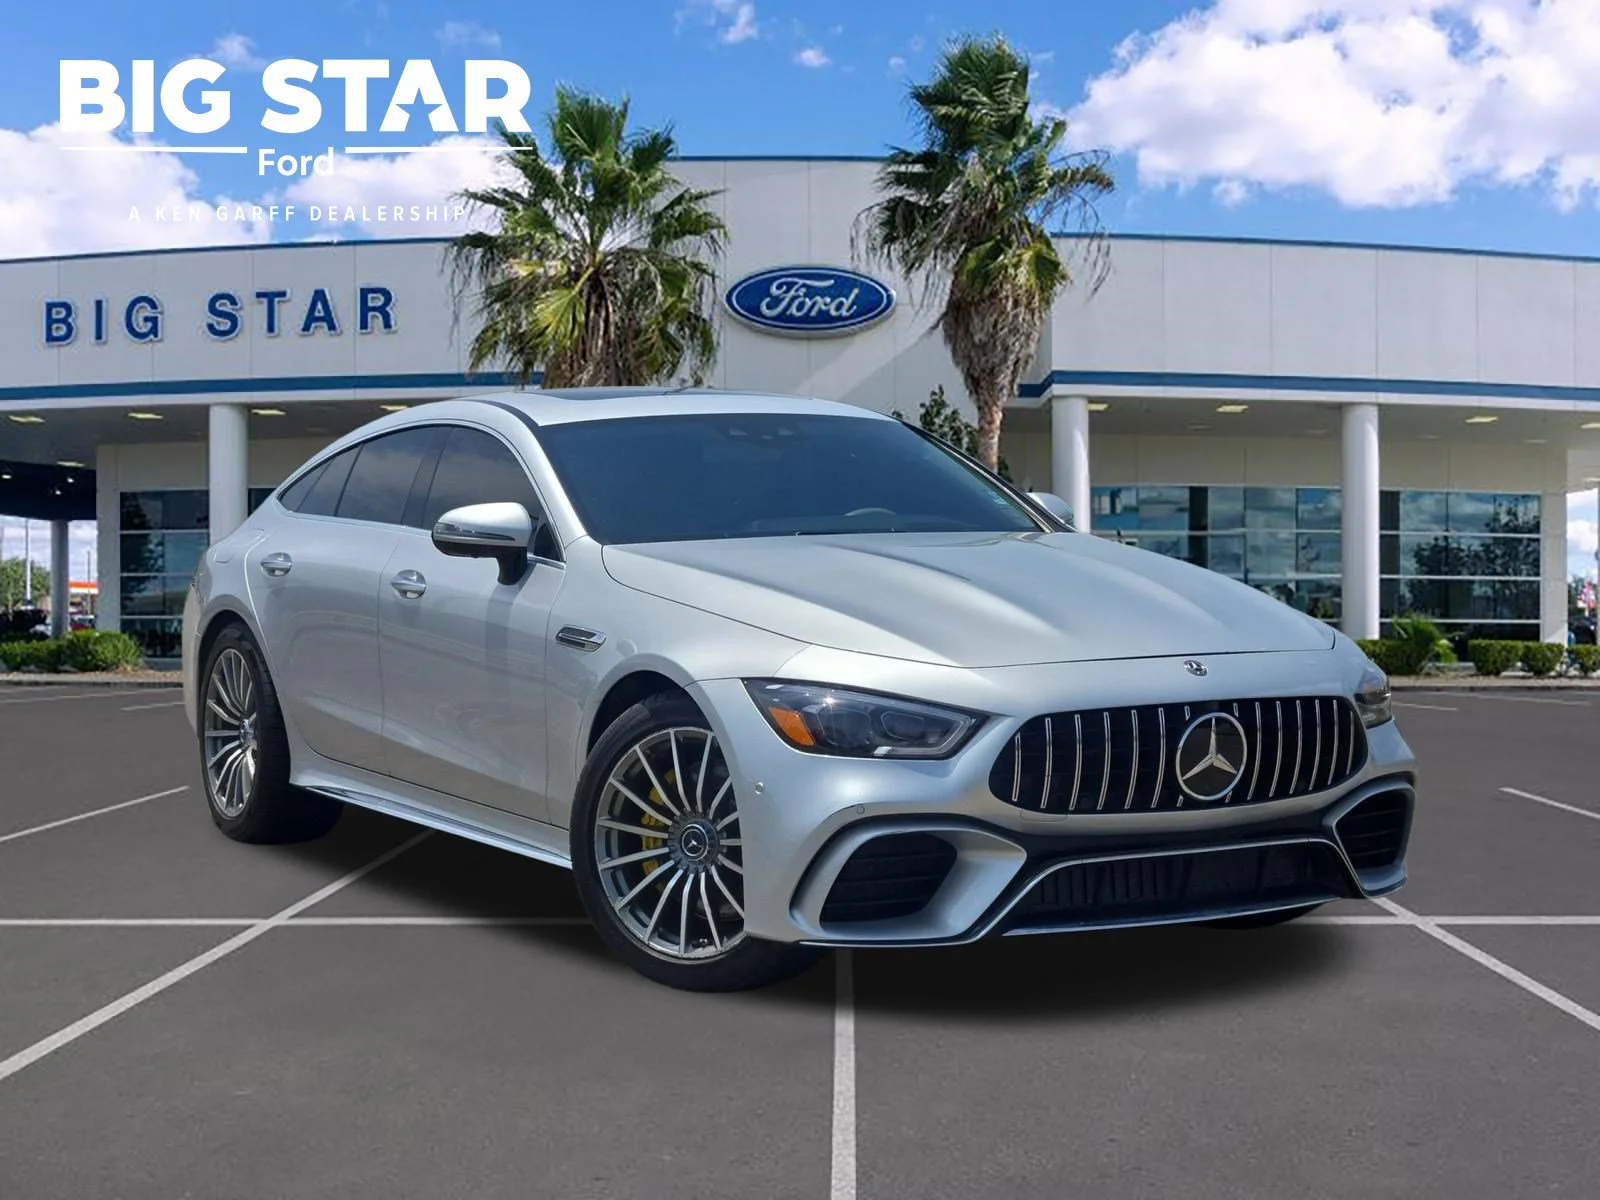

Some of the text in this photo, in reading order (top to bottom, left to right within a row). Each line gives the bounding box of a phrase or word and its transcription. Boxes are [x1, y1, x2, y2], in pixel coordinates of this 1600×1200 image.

[44, 286, 398, 346] BIG STAR
[759, 277, 860, 318] Ford
